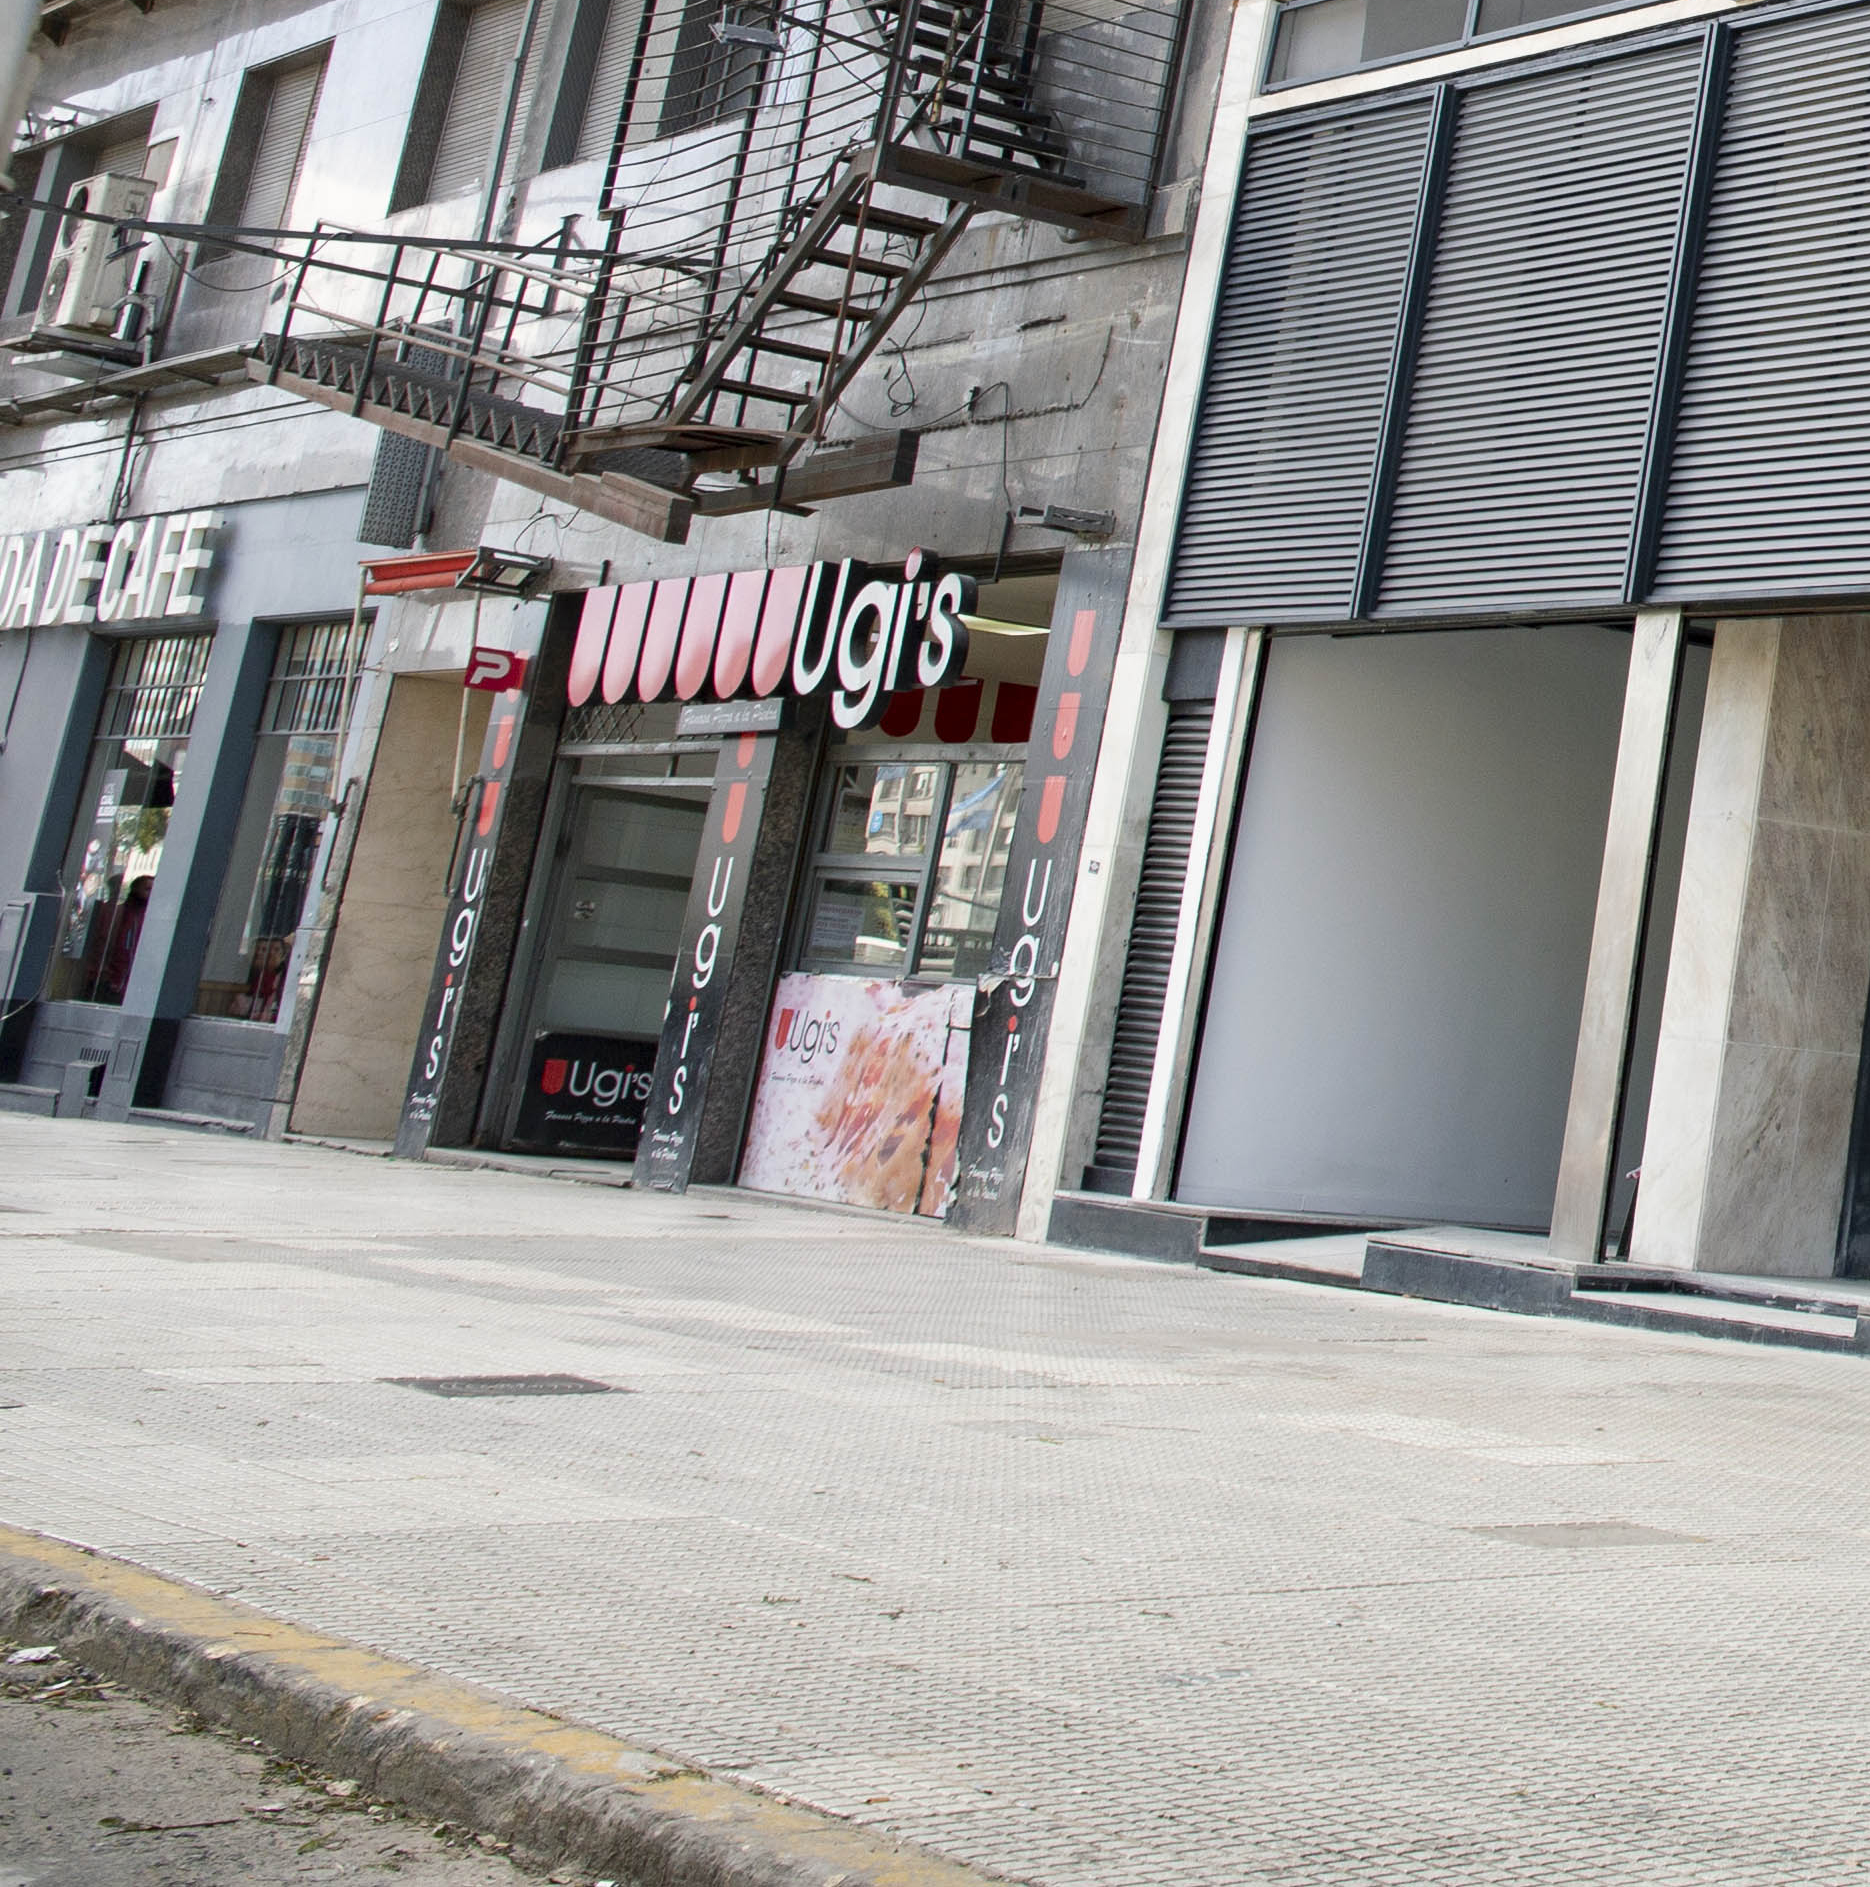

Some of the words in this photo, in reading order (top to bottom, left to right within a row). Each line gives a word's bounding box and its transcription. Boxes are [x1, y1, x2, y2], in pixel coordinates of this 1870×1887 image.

[0, 530, 47, 629] DA
[38, 524, 115, 626] DE
[793, 545, 968, 730] Ugi's
[668, 856, 735, 1115] Ugi's
[789, 1009, 841, 1064] Ugi's
[569, 1059, 653, 1107] Ugi's
